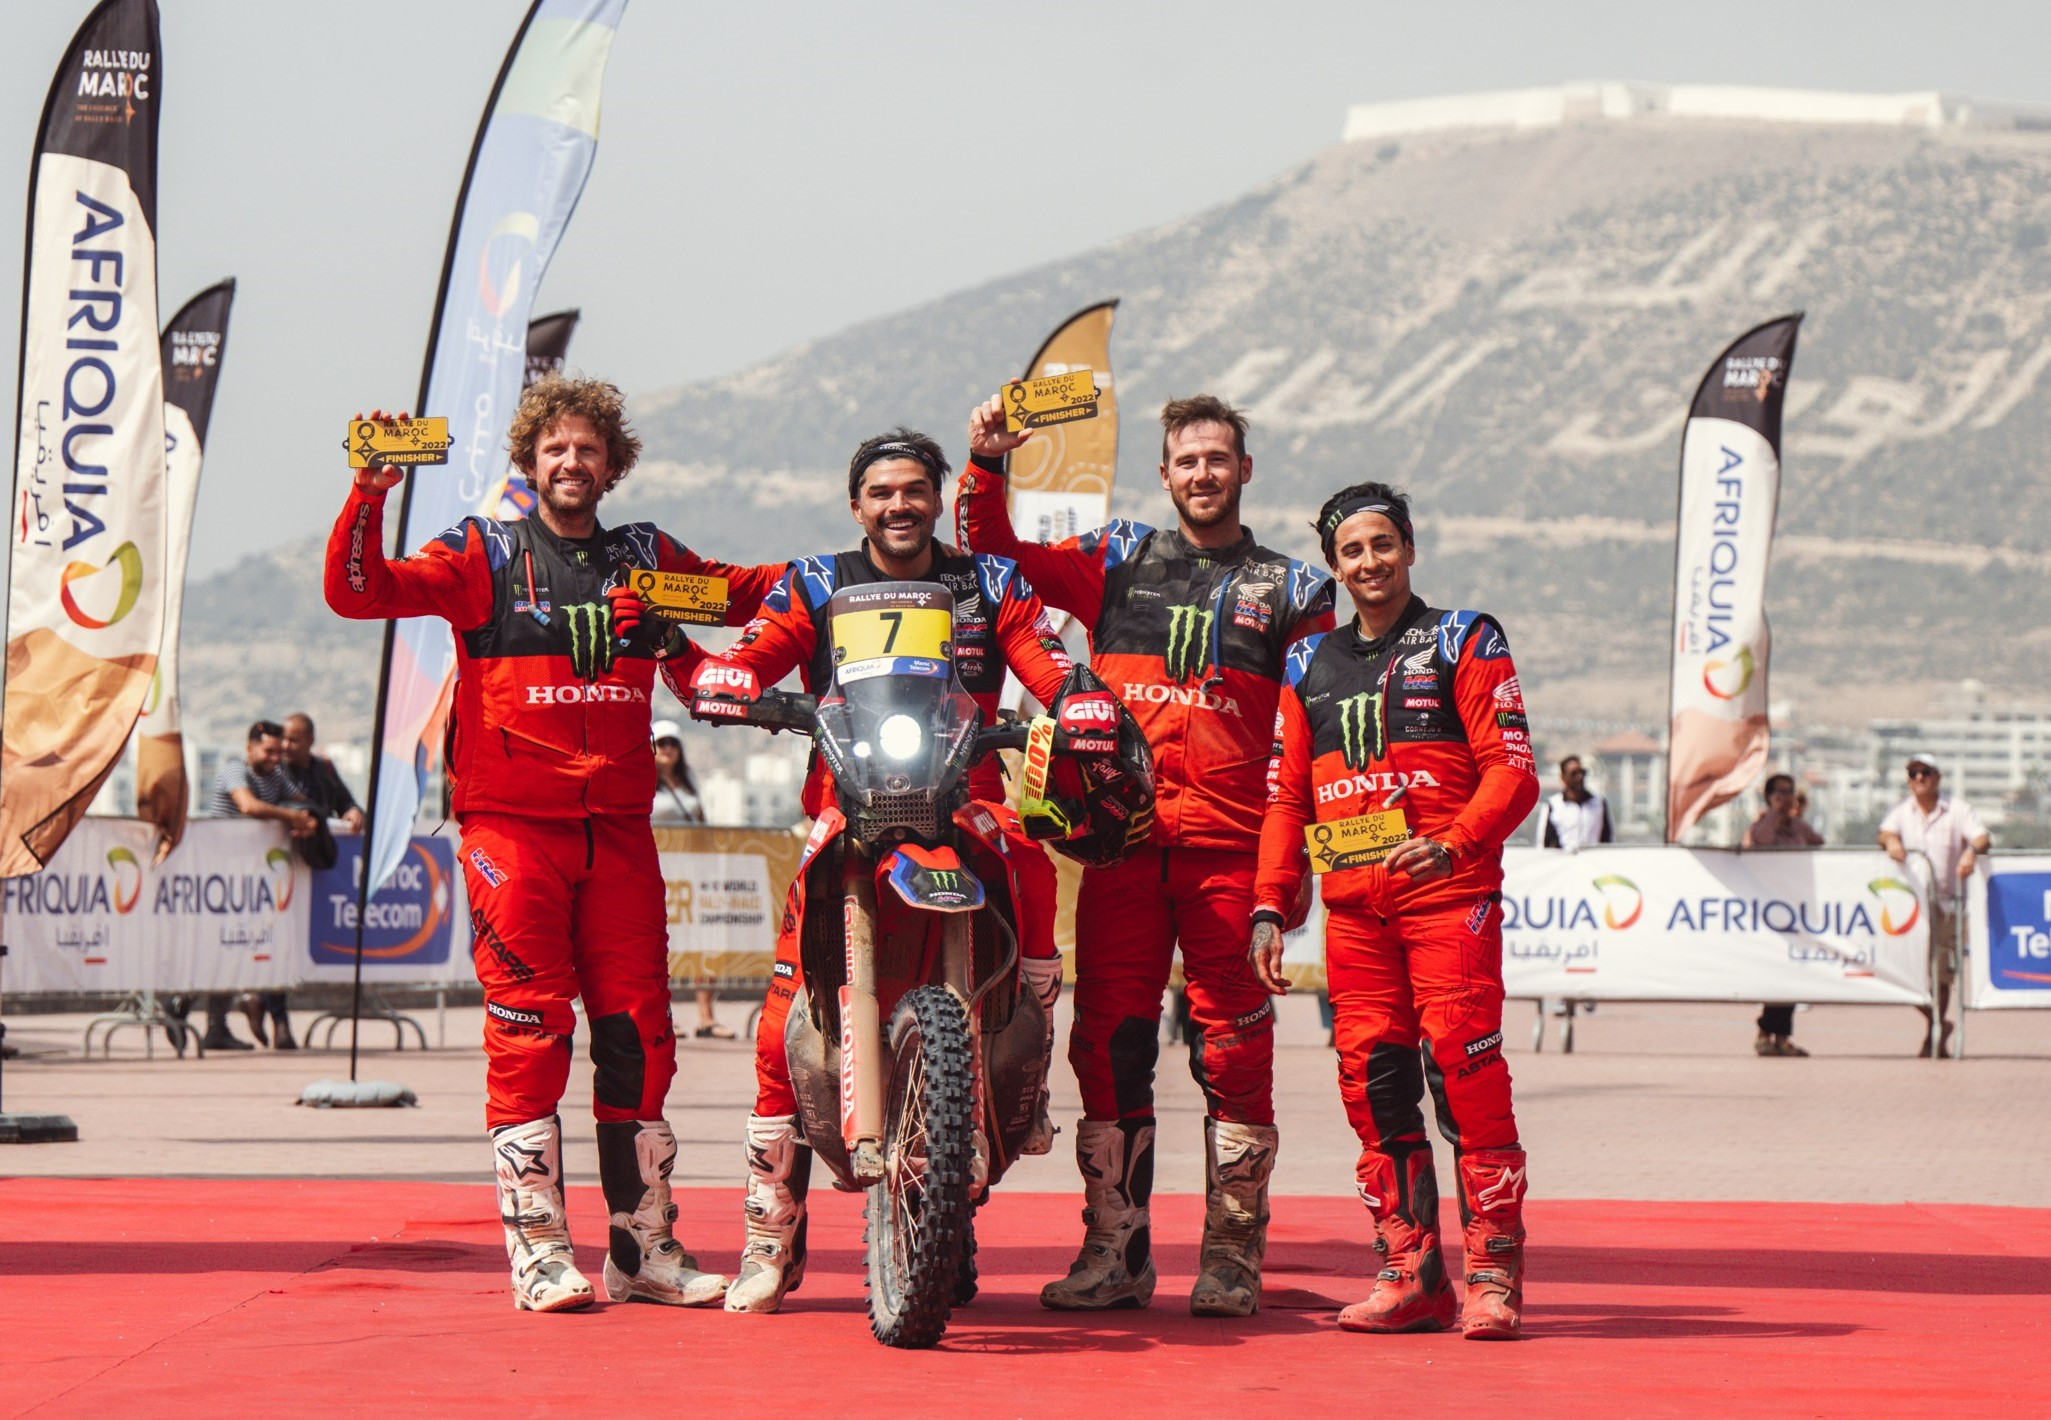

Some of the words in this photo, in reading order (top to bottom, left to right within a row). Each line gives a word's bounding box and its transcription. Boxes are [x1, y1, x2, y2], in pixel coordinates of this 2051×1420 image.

[129, 52, 150, 70] DU
[62, 190, 125, 552] AFRIQUIA
[1033, 377, 1061, 388] RALLYE
[1063, 375, 1075, 383] DU
[1034, 383, 1076, 398] MAROC
[1071, 394, 1094, 404] 2022
[1040, 407, 1086, 423] FINISHER
[383, 428, 429, 438] MAROC
[421, 441, 446, 449] 2022
[386, 453, 435, 463] FINISHER
[346, 503, 370, 593] alpinestars
[1706, 446, 1744, 655] AFRIQUIA
[664, 574, 694, 584] RALLYE
[1263, 570, 1284, 585] BAG
[663, 583, 708, 595] MAROC
[849, 593, 881, 603] RALLYE
[884, 592, 896, 600] DU
[898, 592, 932, 600] MAROC
[700, 601, 725, 610] 2022
[663, 609, 712, 622] FINISHER
[880, 611, 903, 654] 7
[1398, 636, 1417, 645] AIR
[957, 647, 984, 656] MOTUL
[845, 663, 874, 675] AFRIQUIA
[1403, 668, 1439, 676] HONDA
[697, 667, 753, 689] GIVI
[525, 685, 648, 704] HONDA
[1122, 682, 1243, 718] HONDA
[698, 701, 743, 716] MOTUL
[1405, 699, 1439, 708] MOTUL
[1064, 700, 1116, 723] GIVI
[1073, 739, 1114, 751] MOTUL
[1317, 769, 1441, 805] HONDA
[1339, 816, 1370, 828] RALLYE
[1373, 814, 1384, 822] DU
[1341, 822, 1387, 838] MAROC
[1381, 833, 1407, 844] 2022
[1348, 848, 1391, 864] FINISHE
[153, 873, 275, 915] AFRIQUIA
[928, 891, 968, 899] HONDA
[329, 894, 422, 930] Teecom
[1666, 898, 1876, 936] AFRIQUIA
[488, 1003, 541, 1024] HONDA
[842, 1001, 856, 1124] HONDA
